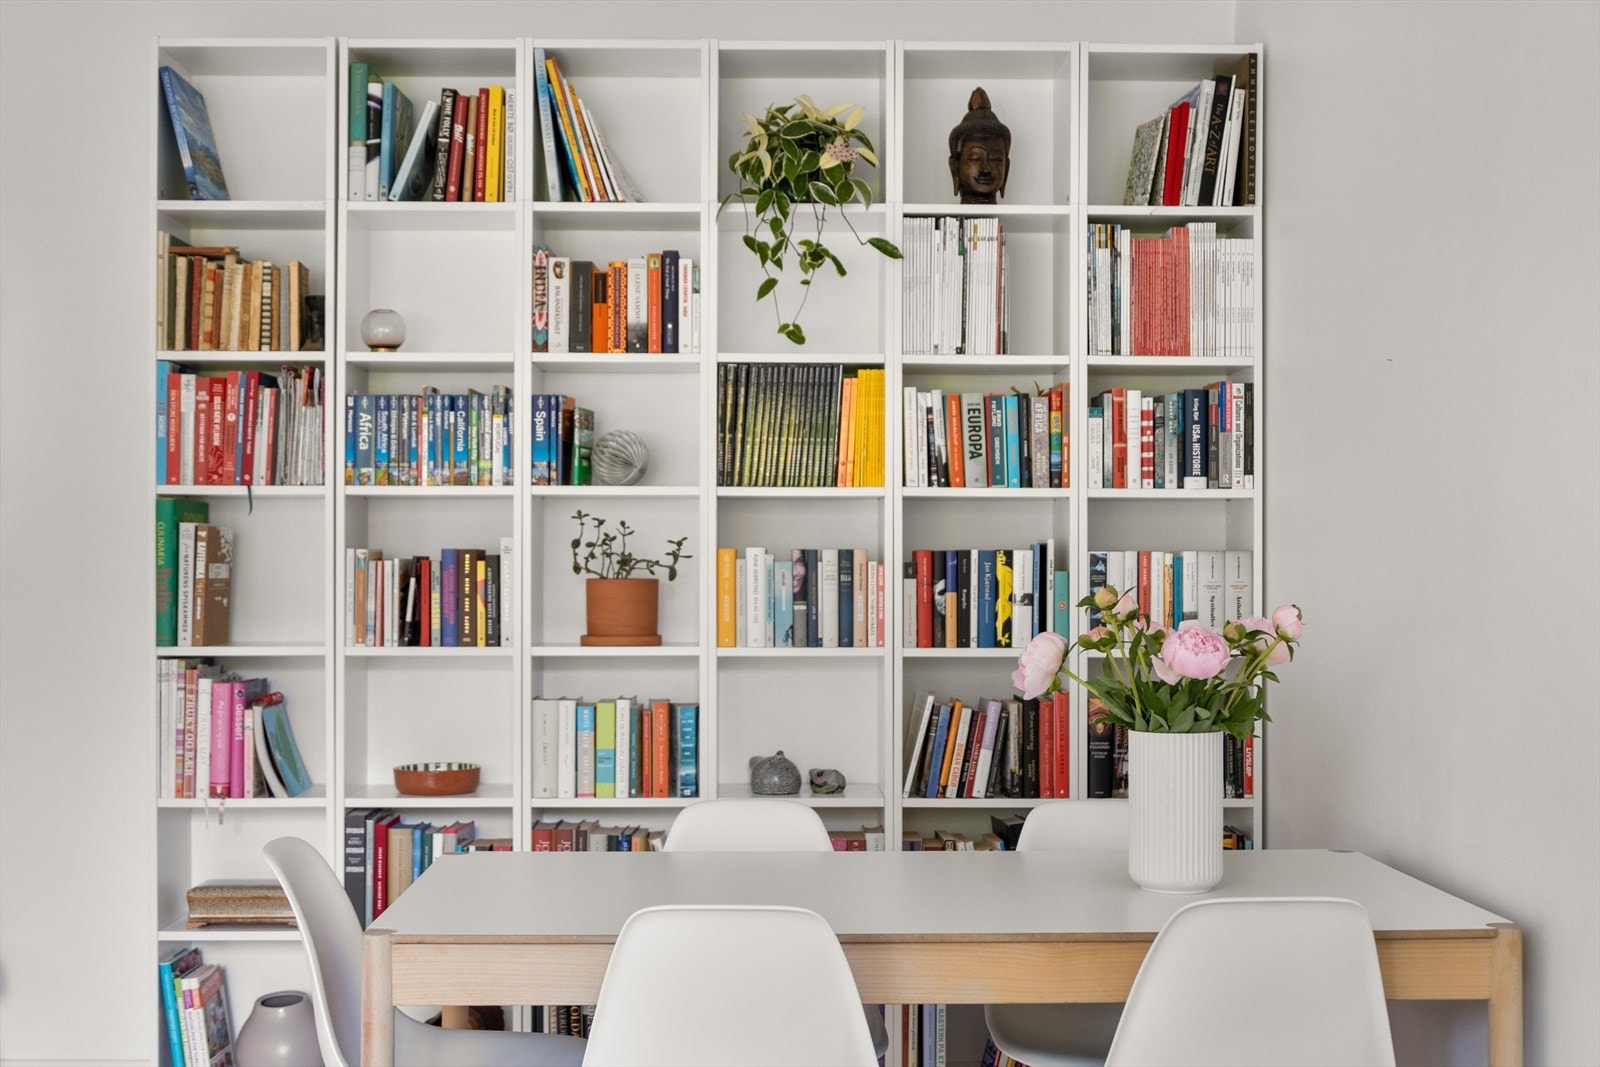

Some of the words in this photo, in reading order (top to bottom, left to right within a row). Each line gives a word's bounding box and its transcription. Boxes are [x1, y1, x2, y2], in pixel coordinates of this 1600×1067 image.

[444, 97, 452, 115] WINE
[1215, 103, 1224, 115] The
[1210, 116, 1221, 138] A-Z
[1204, 148, 1216, 175] ART
[534, 265, 546, 308] INDIA
[359, 412, 372, 450] Africa
[456, 411, 465, 451] California
[534, 410, 546, 440] Spain
[967, 408, 982, 460] EUROPA
[1192, 443, 1200, 475] HISTORIE
[1234, 434, 1243, 468] Organizations
[157, 522, 165, 565] CULINARIA
[196, 541, 206, 579] KAFFEBOKA
[157, 568, 173, 612] Italia
[185, 694, 195, 732] FRUKT
[234, 704, 244, 741] dessert
[185, 733, 194, 749] OG
[954, 742, 964, 765] HUMAN
[184, 751, 193, 776] BÆR
[950, 766, 962, 787] CARGO
[970, 761, 978, 781] KOREA
[938, 1055, 944, 1065] ET
